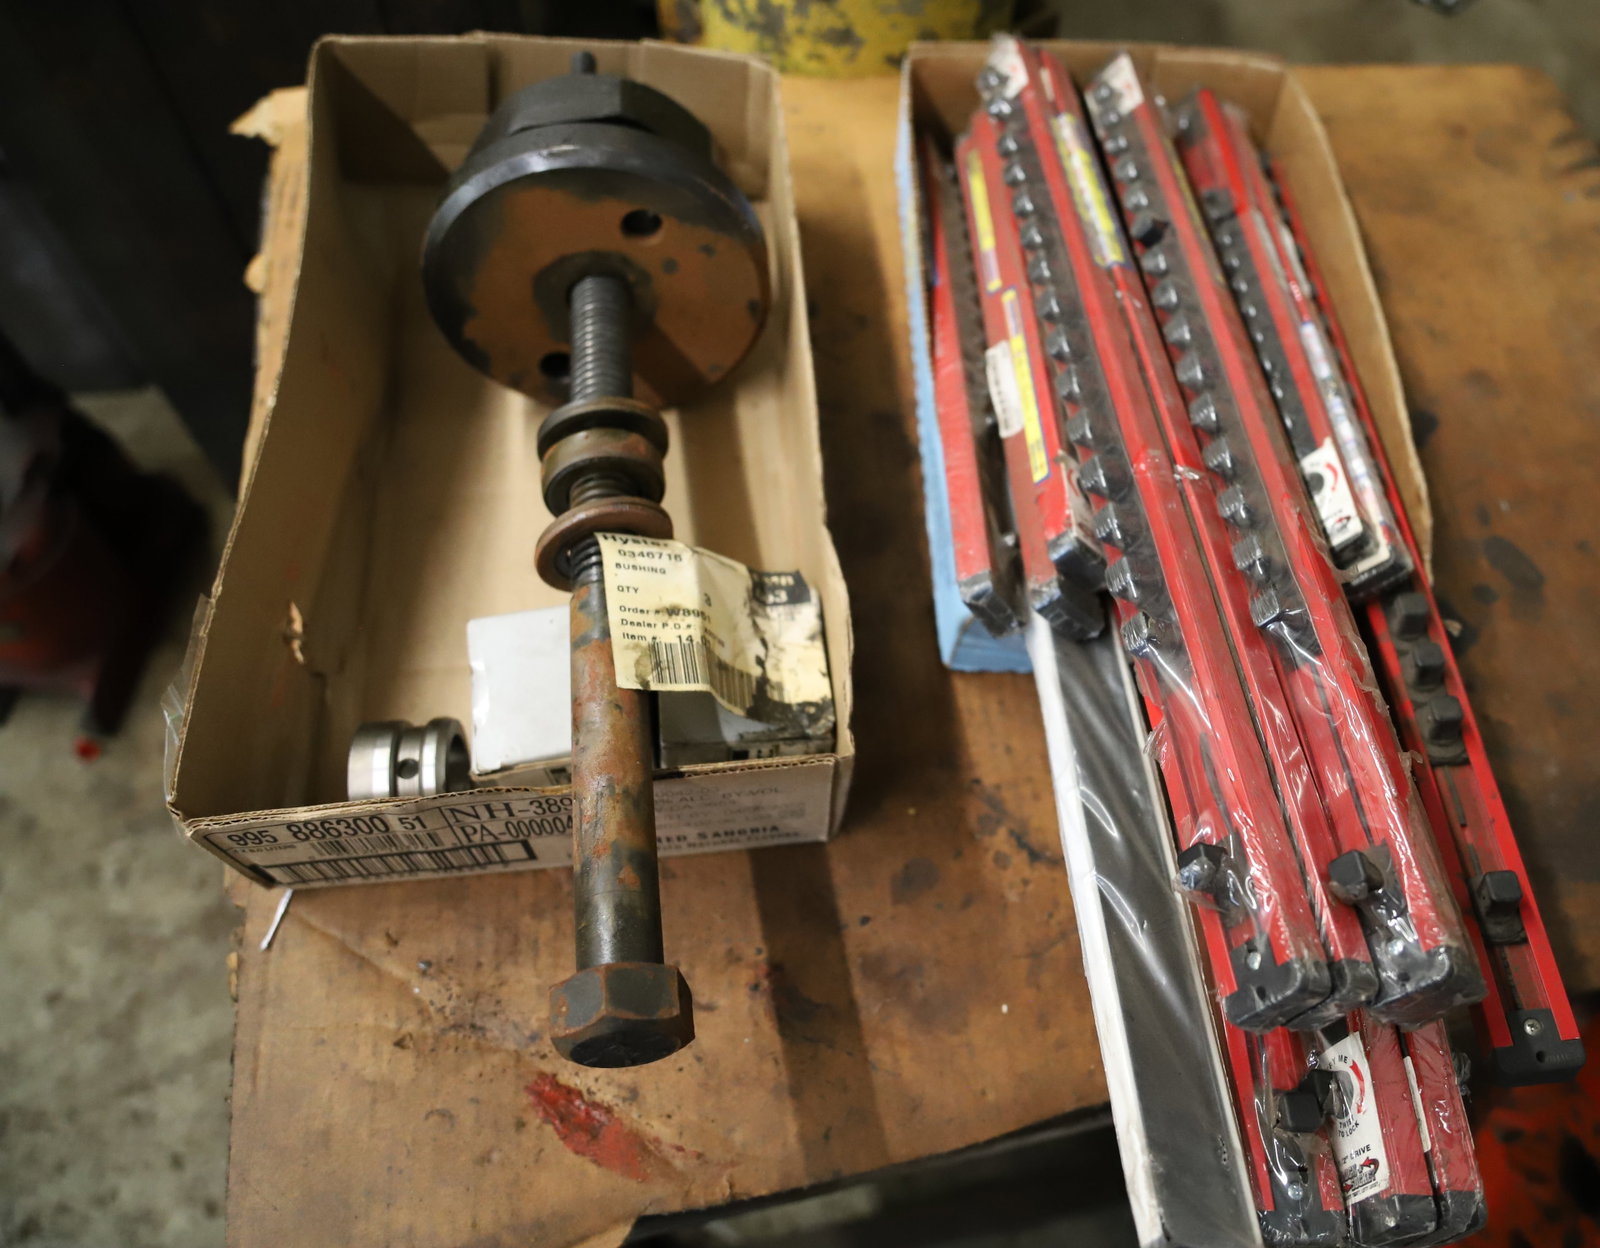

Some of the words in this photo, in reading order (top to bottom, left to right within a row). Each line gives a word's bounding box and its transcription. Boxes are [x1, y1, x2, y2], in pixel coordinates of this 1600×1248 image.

[615, 562, 667, 575] BUSHING
[617, 585, 640, 594] QTY
[619, 605, 650, 615] Order
[621, 618, 657, 629] Dealer
[622, 632, 647, 642] Item
[227, 830, 278, 847] 995
[286, 815, 391, 842] 886300
[397, 815, 427, 831] 51
[697, 824, 780, 840] SANGRIA
[1338, 1054, 1348, 1064] ME
[1346, 1119, 1360, 1137] LOCK
